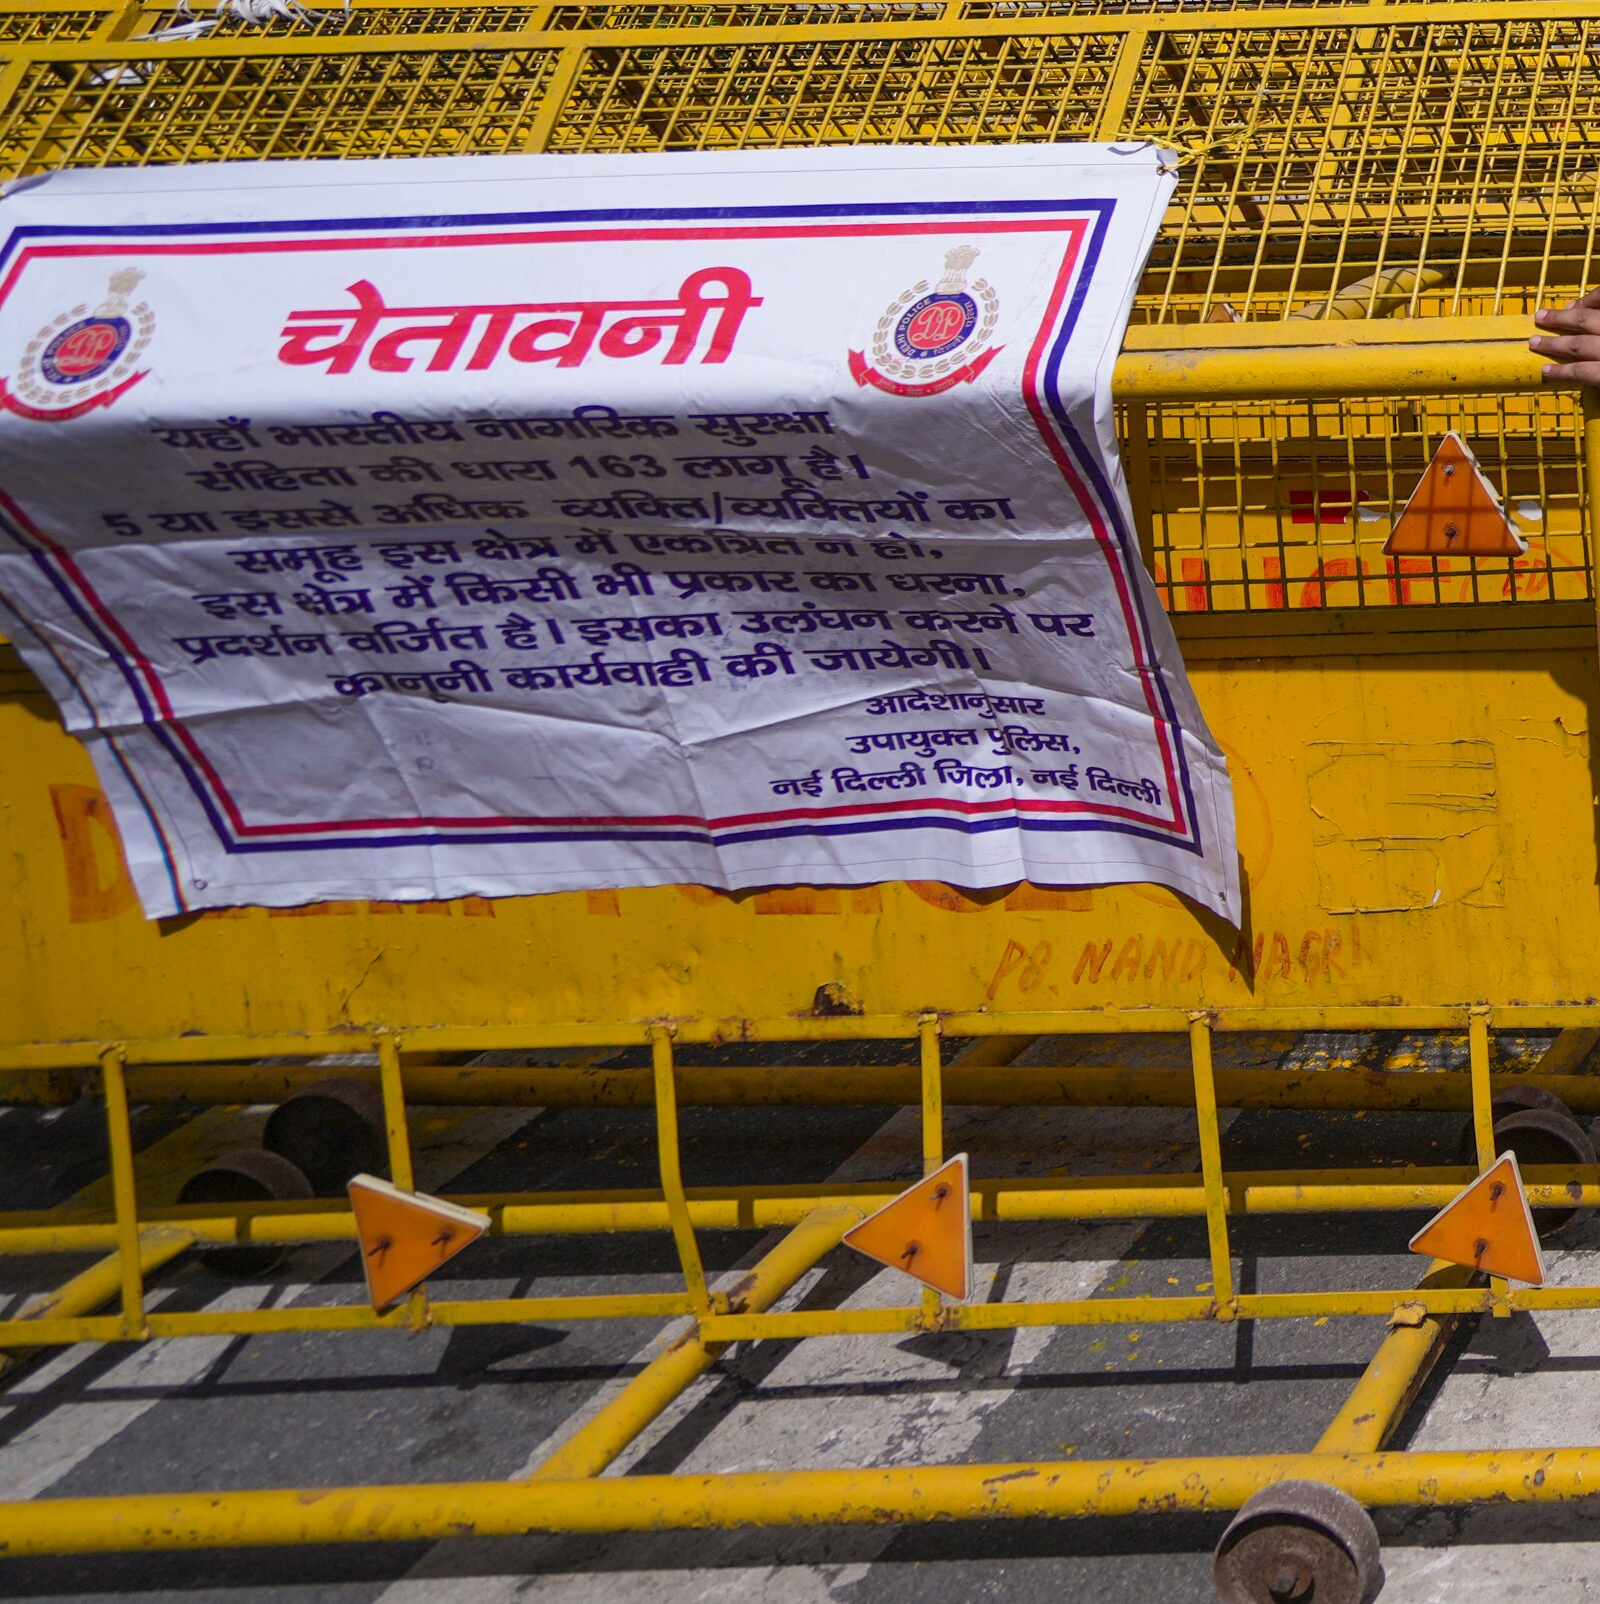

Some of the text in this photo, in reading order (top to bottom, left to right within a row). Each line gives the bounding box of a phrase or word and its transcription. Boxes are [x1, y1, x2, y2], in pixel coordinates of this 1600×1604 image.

[277, 266, 765, 375] चेतावनी
[898, 297, 931, 331] POLICE
[151, 405, 834, 452] यहाँ भारतीय नागरिक सुरक्षा
[186, 460, 357, 492] संहिता
[359, 456, 444, 484] की
[450, 460, 557, 483] धारा
[568, 454, 667, 480] 163
[674, 455, 817, 489] लागू
[102, 513, 143, 537] 5
[149, 511, 220, 533] या
[222, 499, 362, 532] इससे
[372, 493, 530, 526] अधिक
[938, 497, 1017, 521] का
[227, 544, 363, 583] समूह
[370, 540, 463, 569] इस
[473, 528, 559, 560] क्षेत्र
[623, 529, 804, 557] एकत्रित
[808, 538, 858, 557] न
[193, 562, 1026, 619] इस क्षेत्र में किसी भी प्रकार का धरना,
[173, 624, 334, 664] प्रदर्शन
[340, 617, 488, 655] वर्जित
[570, 612, 723, 646] इसका
[731, 602, 893, 635] उलंघन
[899, 603, 1020, 634] करने
[1027, 613, 1096, 637] पर
[500, 648, 712, 690] कार्यवाही
[721, 642, 796, 678] की
[803, 639, 993, 671] जायेगी।
[865, 688, 1046, 719] आदेशानुसार
[845, 724, 1081, 759] उपायुक्त पुलिस,
[770, 757, 1162, 807] नई दिल्ली जिला, नई दिल्ली
[1073, 936, 1202, 985] NAND
[1229, 925, 1362, 988] NAGRI
